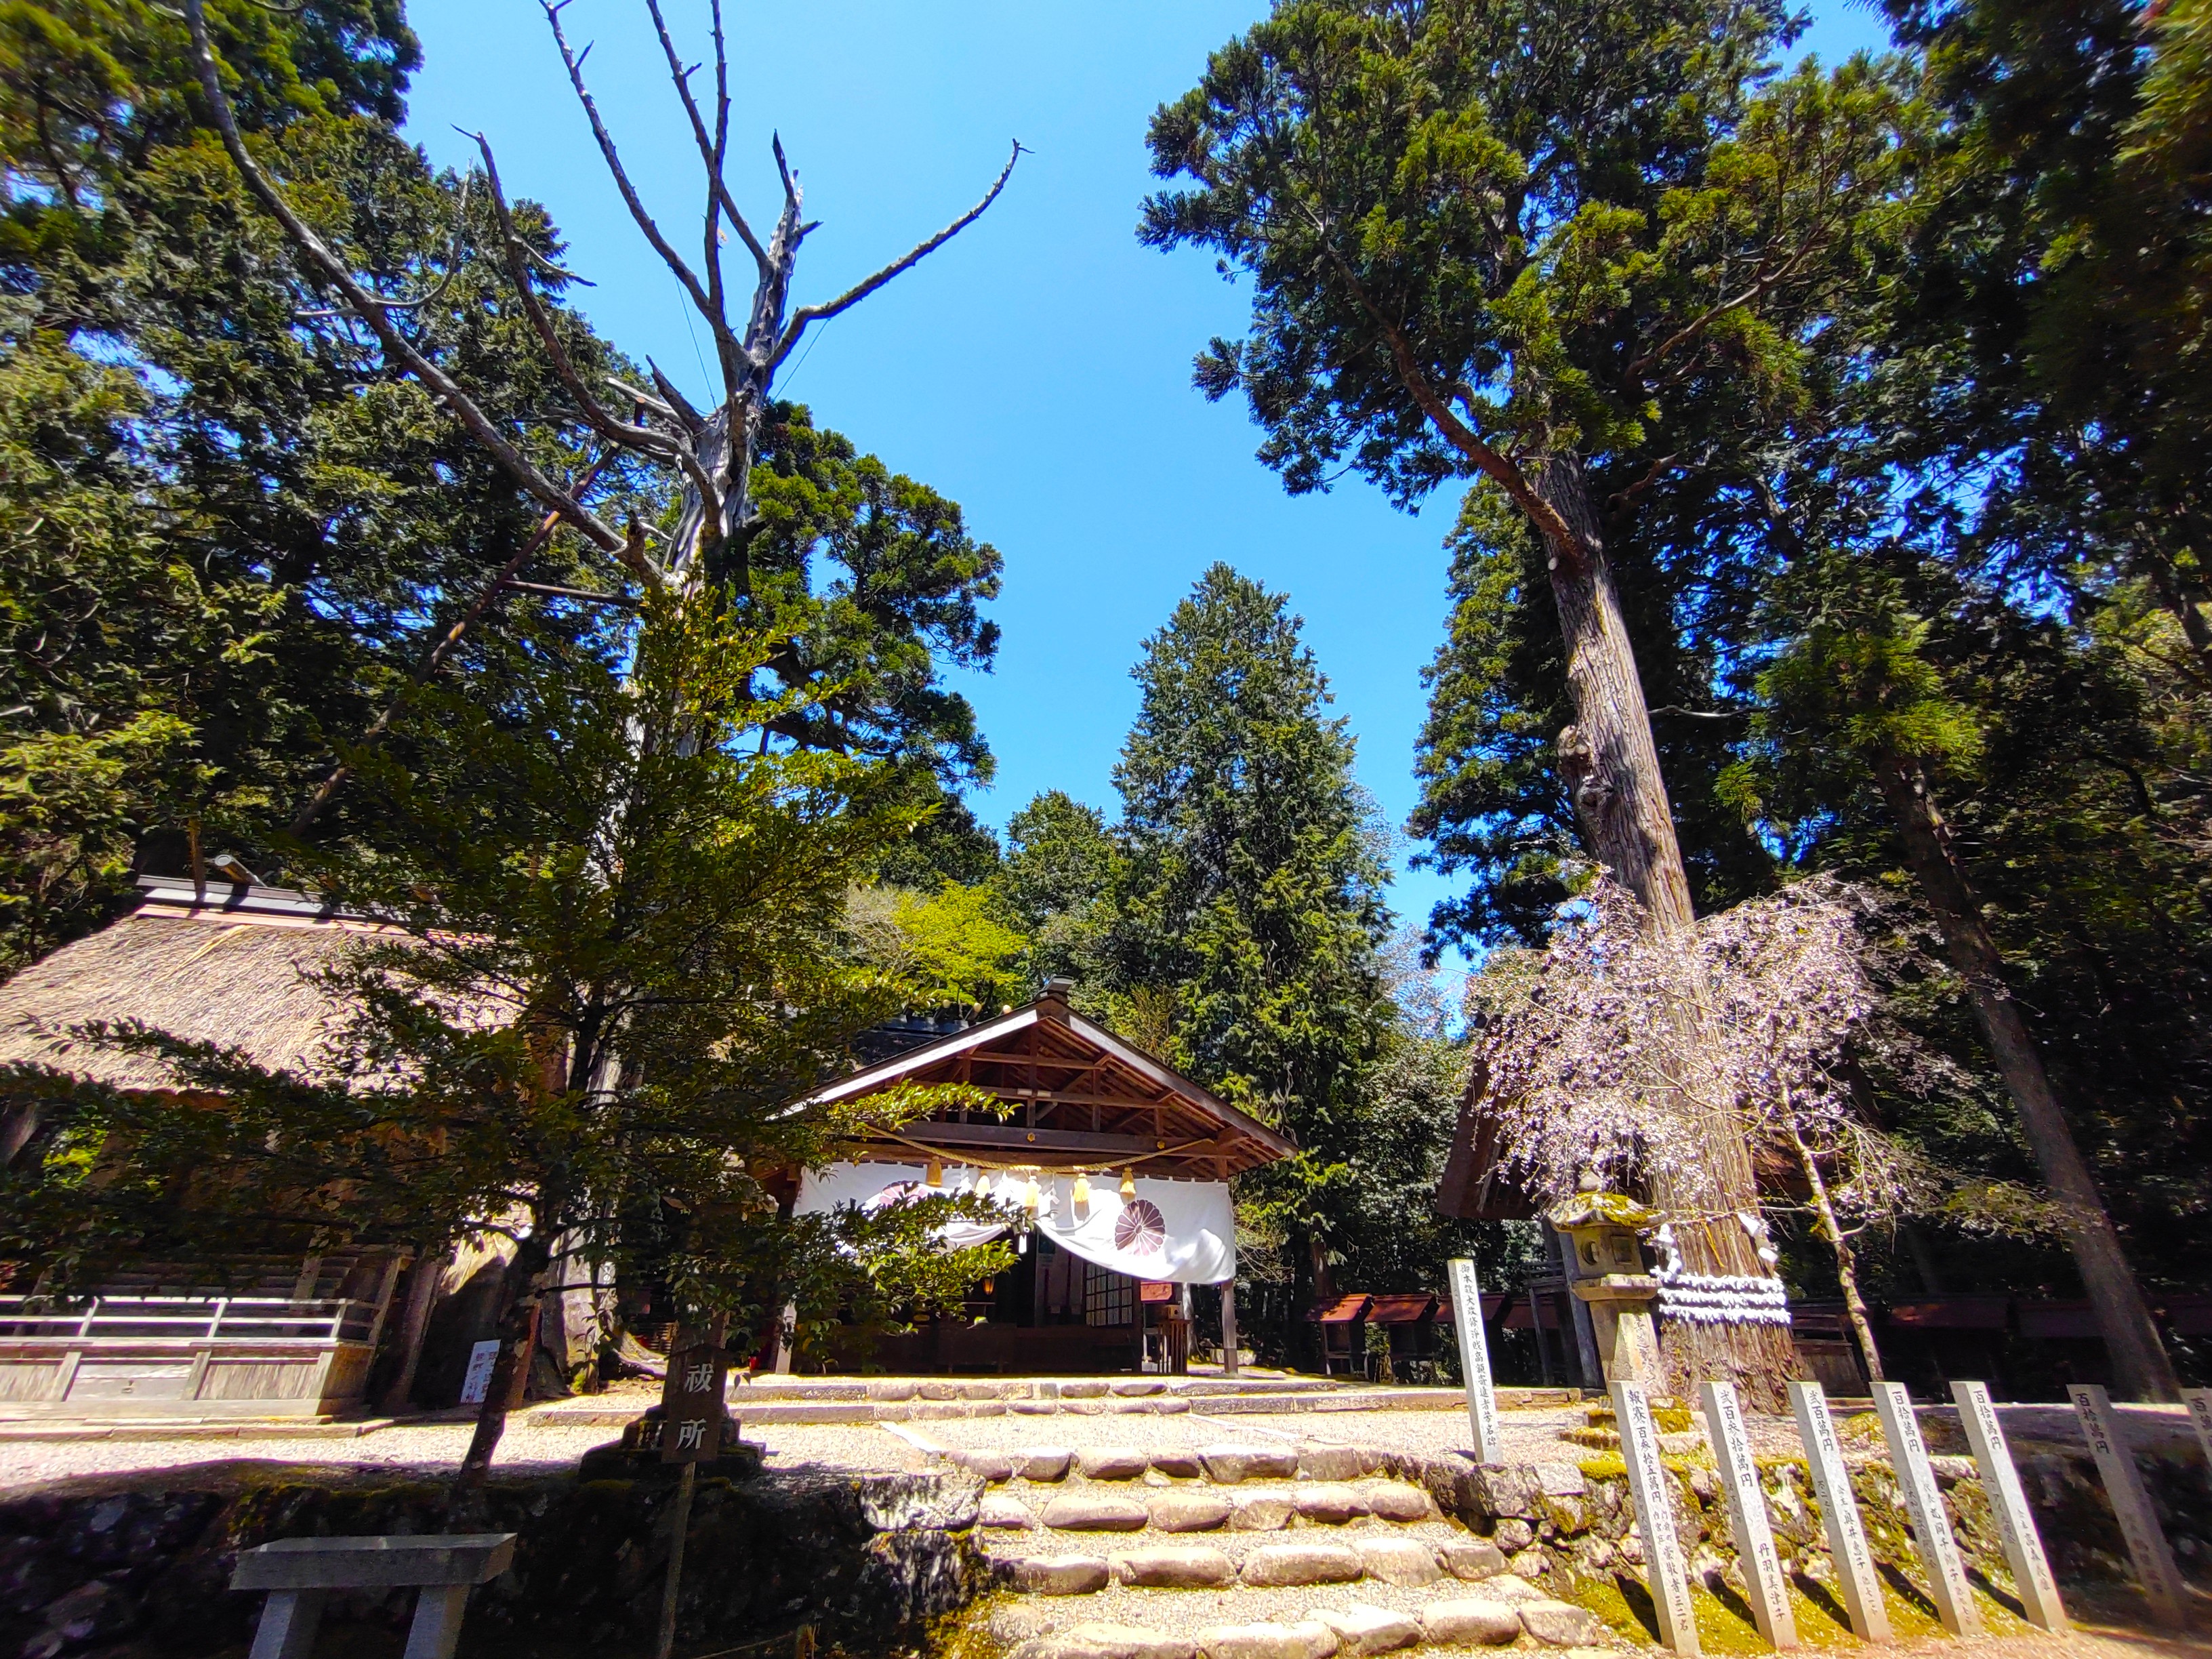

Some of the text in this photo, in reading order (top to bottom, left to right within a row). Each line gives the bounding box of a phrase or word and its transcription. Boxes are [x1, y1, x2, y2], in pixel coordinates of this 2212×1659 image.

[675, 1363, 714, 1450] 祓所
[1891, 1391, 1921, 1453] 百拾萬円
[1973, 1389, 2002, 1450] 百拾萬円
